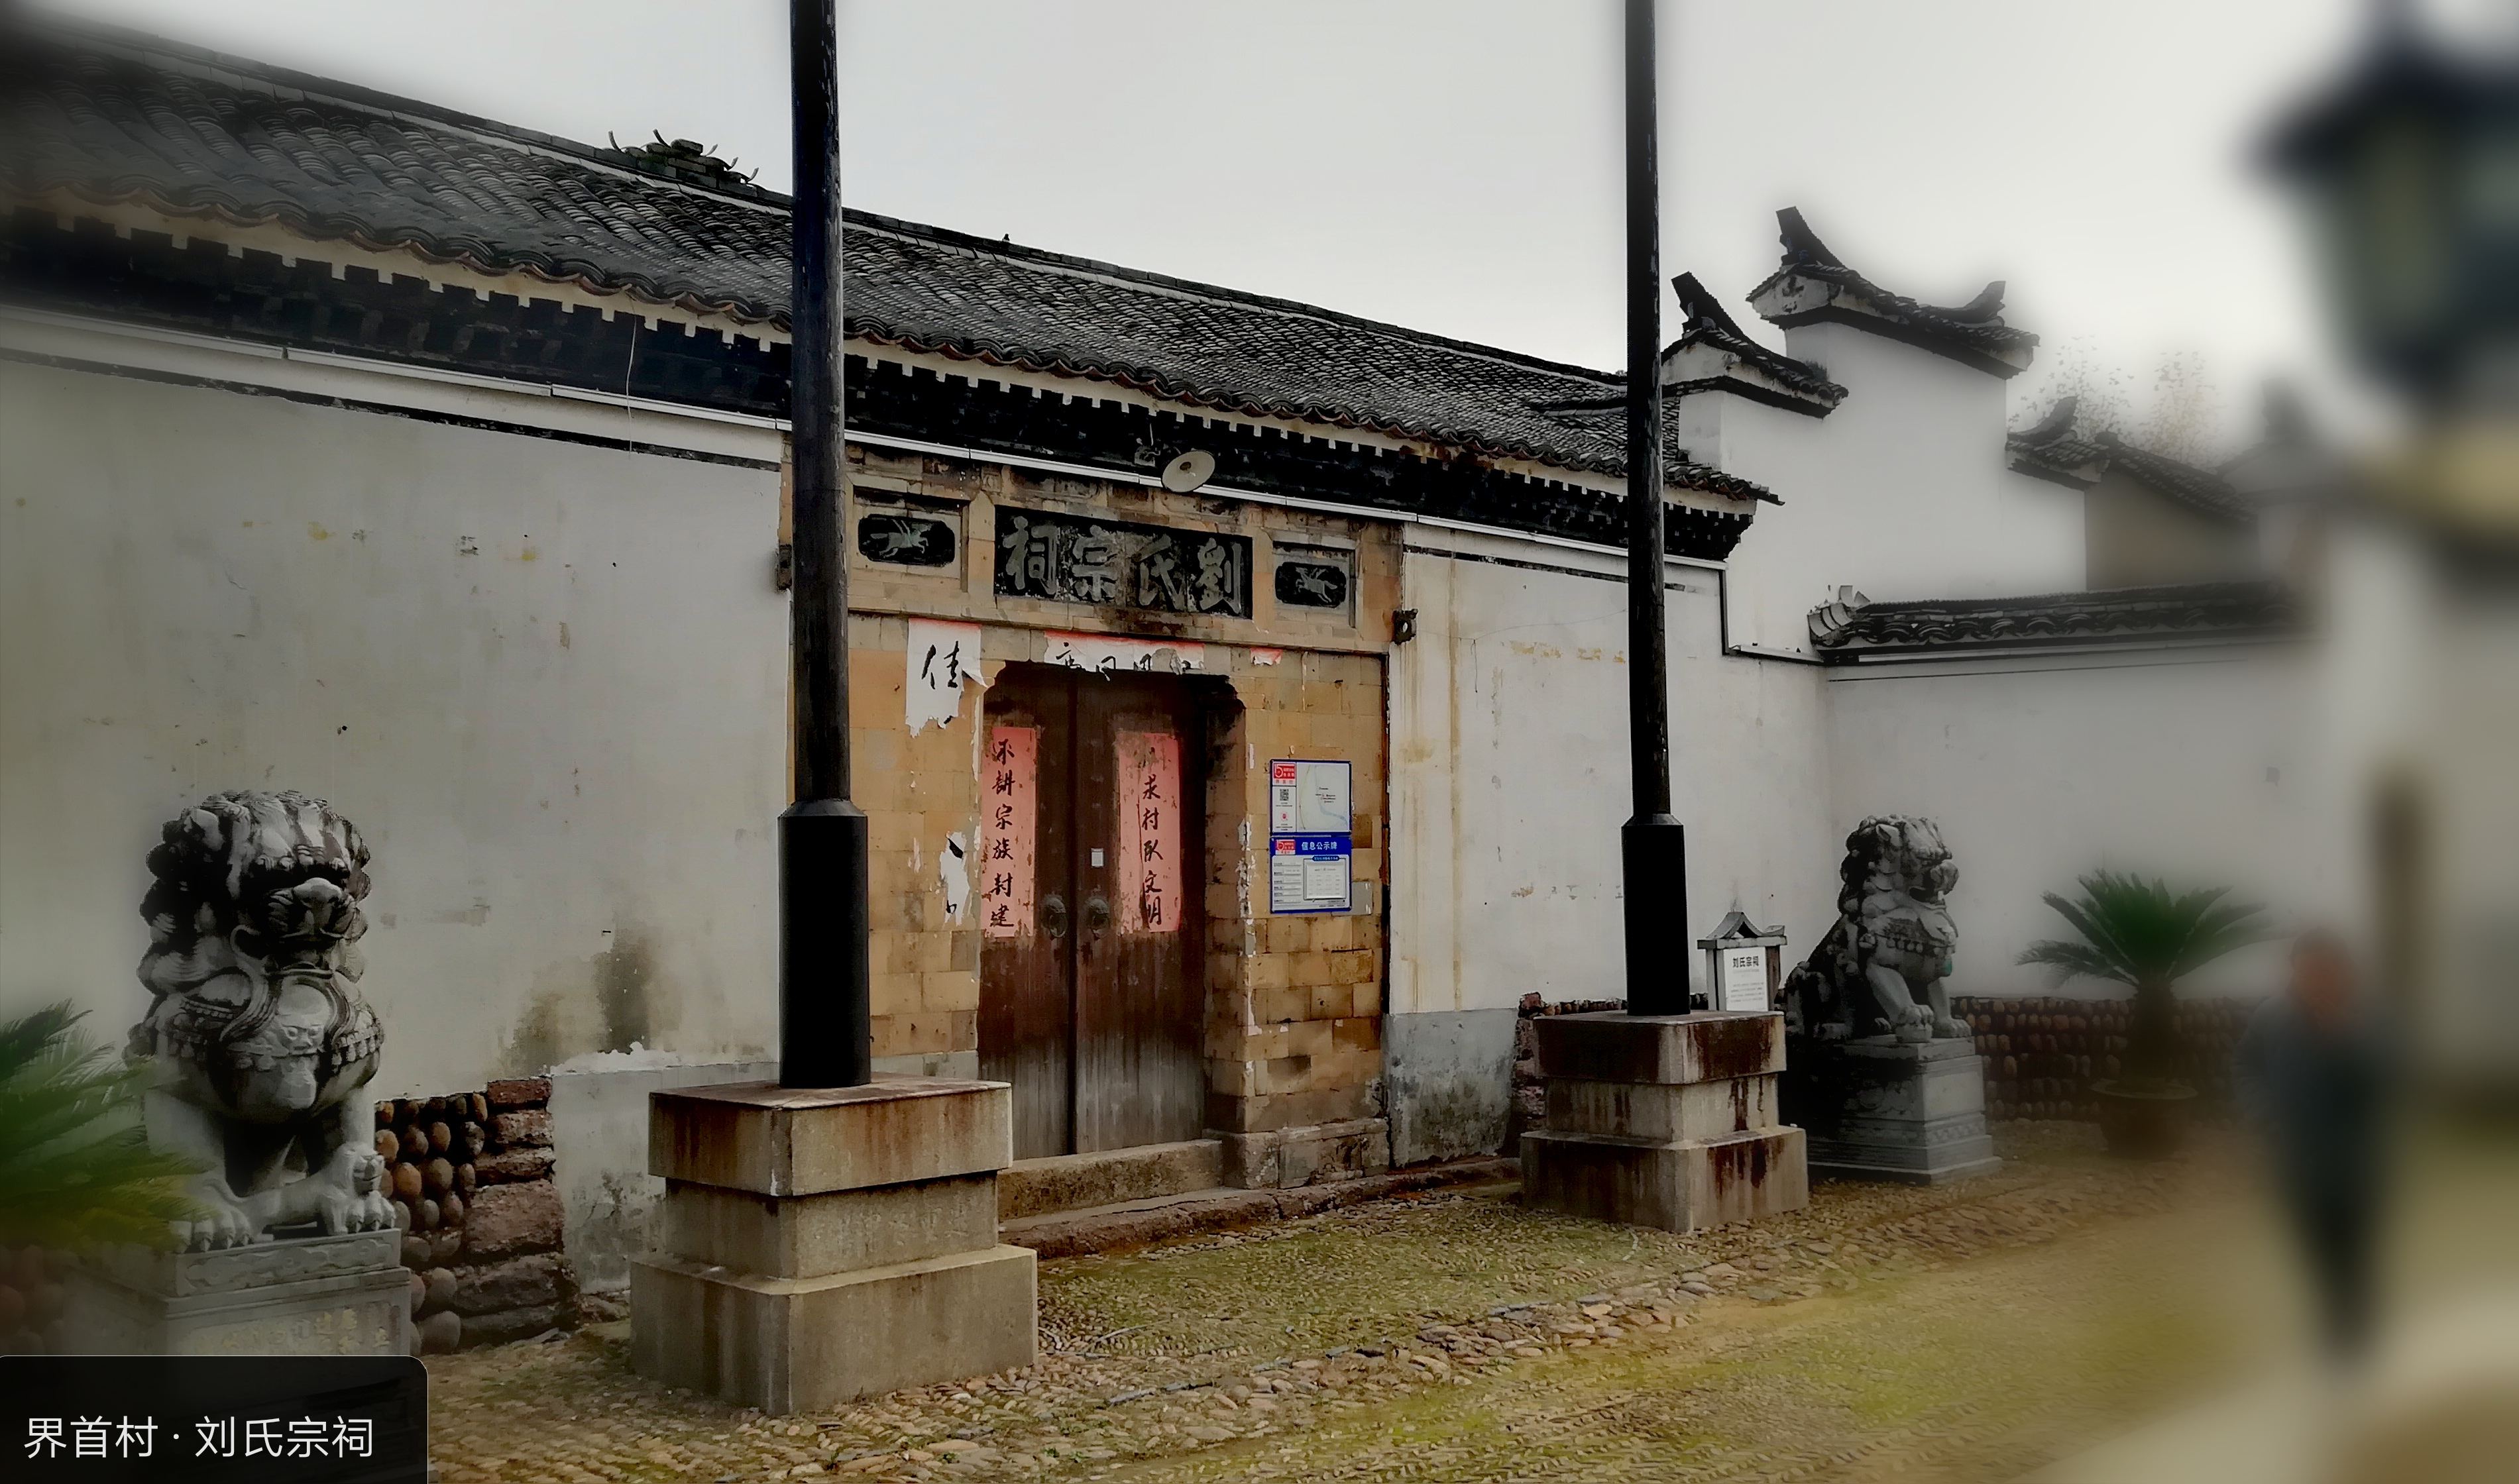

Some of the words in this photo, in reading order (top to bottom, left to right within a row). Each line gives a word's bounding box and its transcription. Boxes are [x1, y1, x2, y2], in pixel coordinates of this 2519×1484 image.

[1301, 841, 1337, 851] 信息公示牌
